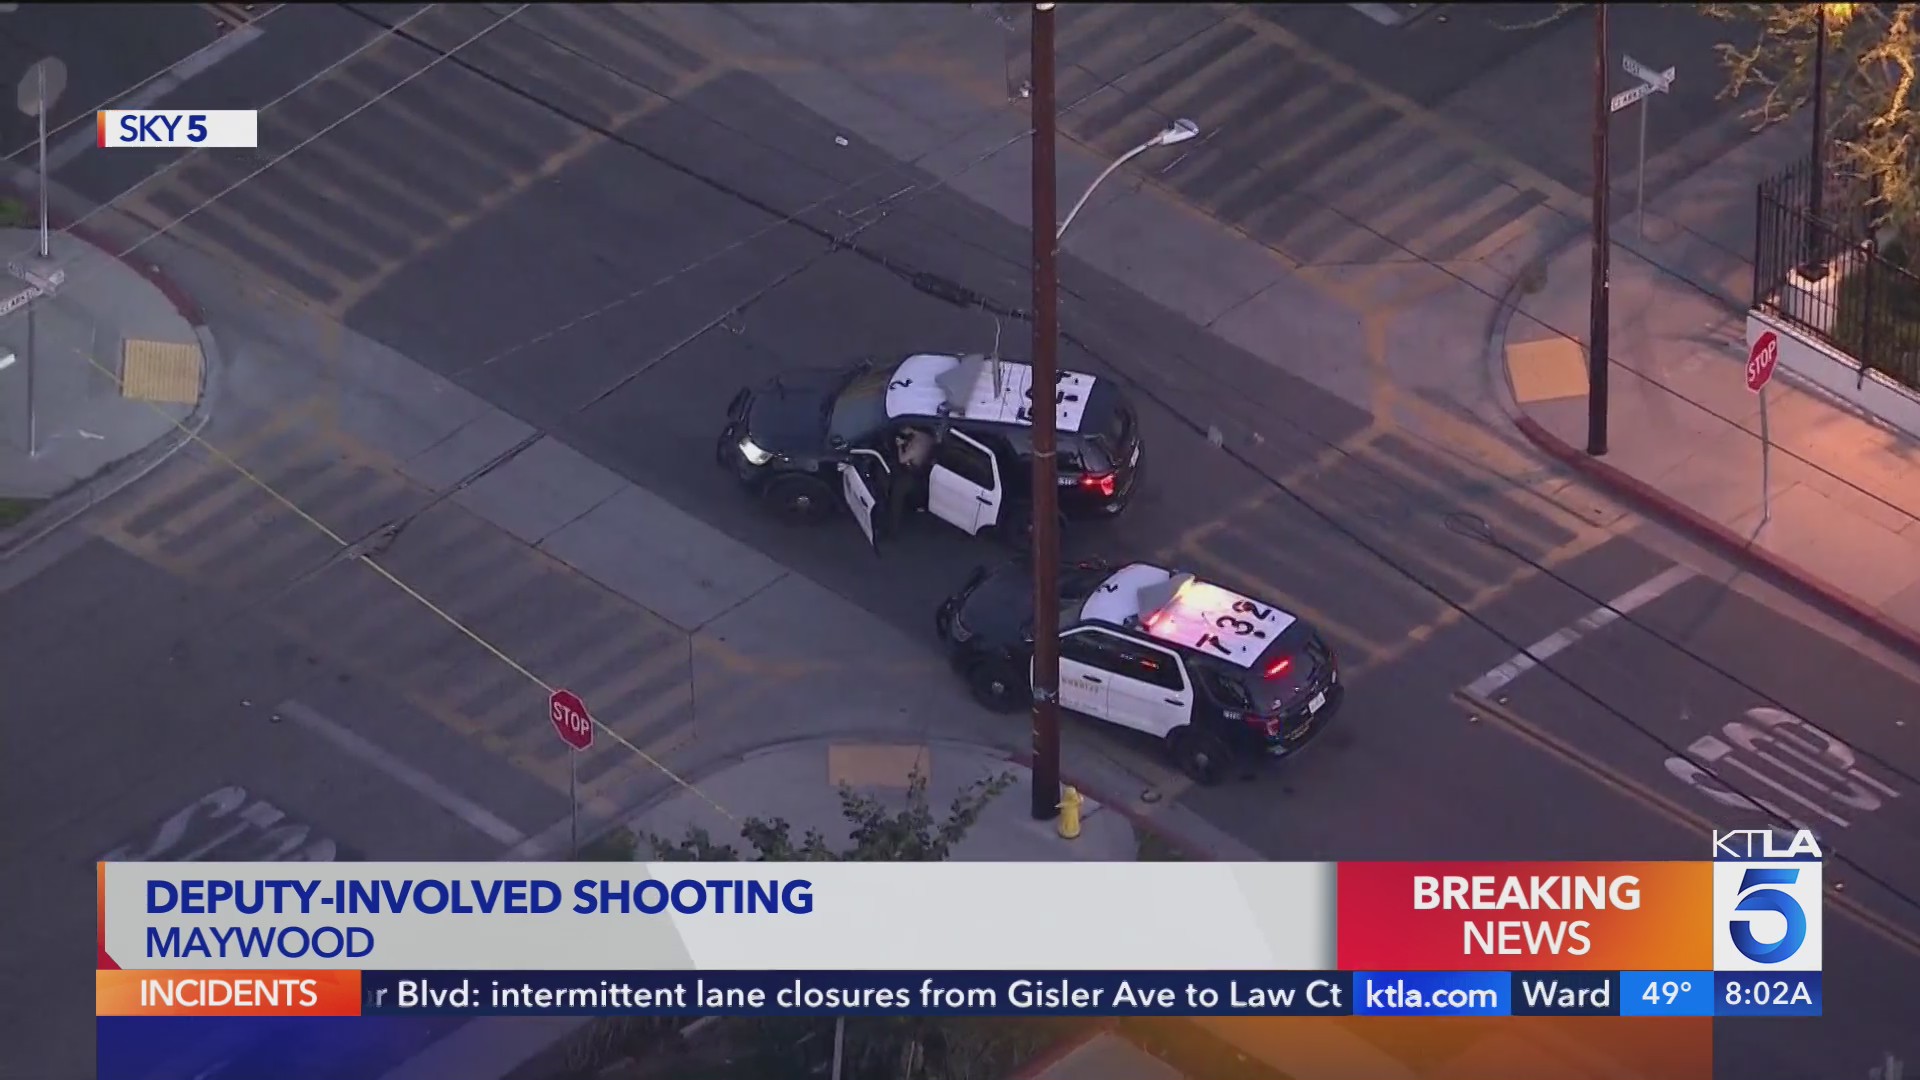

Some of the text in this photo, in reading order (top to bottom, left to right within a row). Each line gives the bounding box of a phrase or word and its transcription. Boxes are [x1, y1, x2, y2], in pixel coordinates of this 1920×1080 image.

[1748, 339, 1776, 382] STOP
[1195, 599, 1276, 656] 732
[553, 701, 590, 736] STOP
